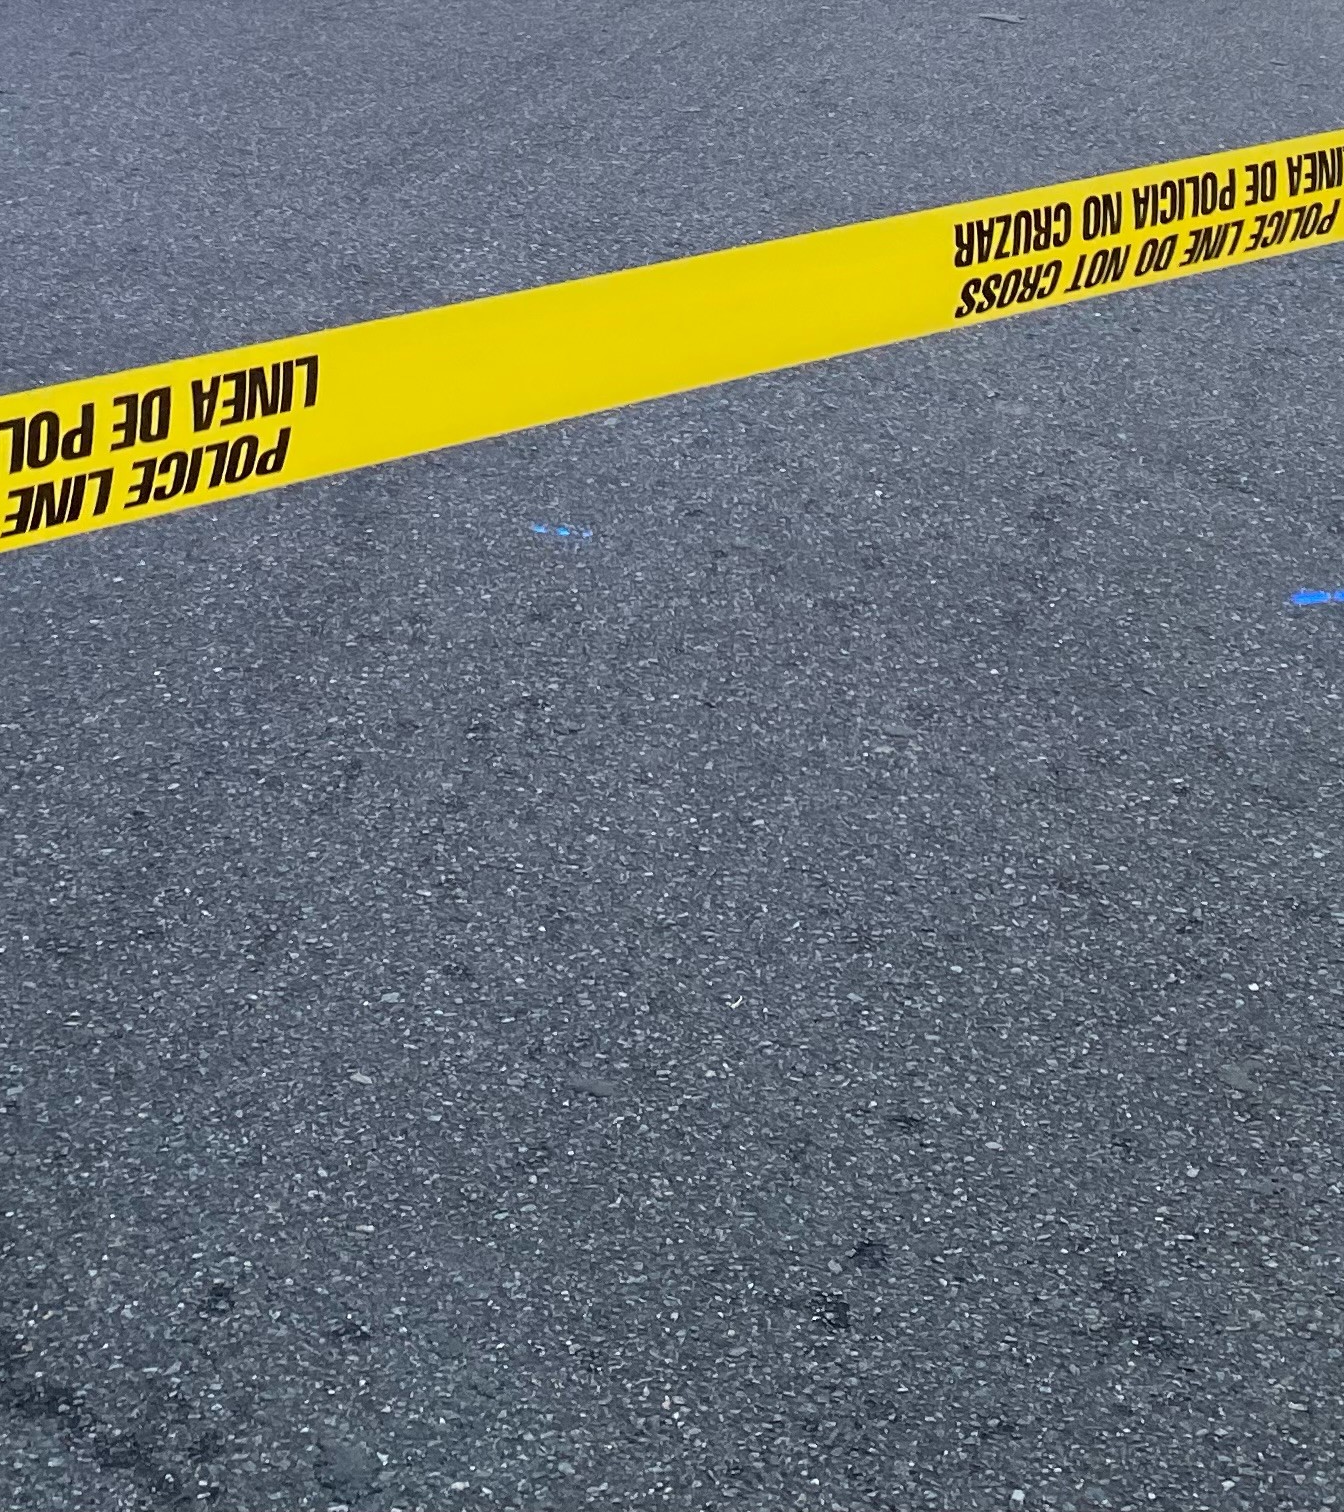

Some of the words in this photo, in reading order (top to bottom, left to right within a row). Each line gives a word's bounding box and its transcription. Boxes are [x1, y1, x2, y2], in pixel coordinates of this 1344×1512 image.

[1133, 169, 1235, 229] POLICIA
[1245, 161, 1276, 206] DE
[954, 201, 1071, 268] CRUZAR
[1083, 192, 1122, 240] NO
[1179, 219, 1243, 266] LINE
[1245, 199, 1340, 252] POLICE
[1065, 244, 1131, 292] NOT
[1135, 234, 1178, 276] DO
[955, 259, 1063, 318] CROSS
[110, 386, 172, 452] DE
[192, 353, 319, 433] LINEA
[123, 426, 291, 509] POLICE
[0, 467, 114, 538] LINE
